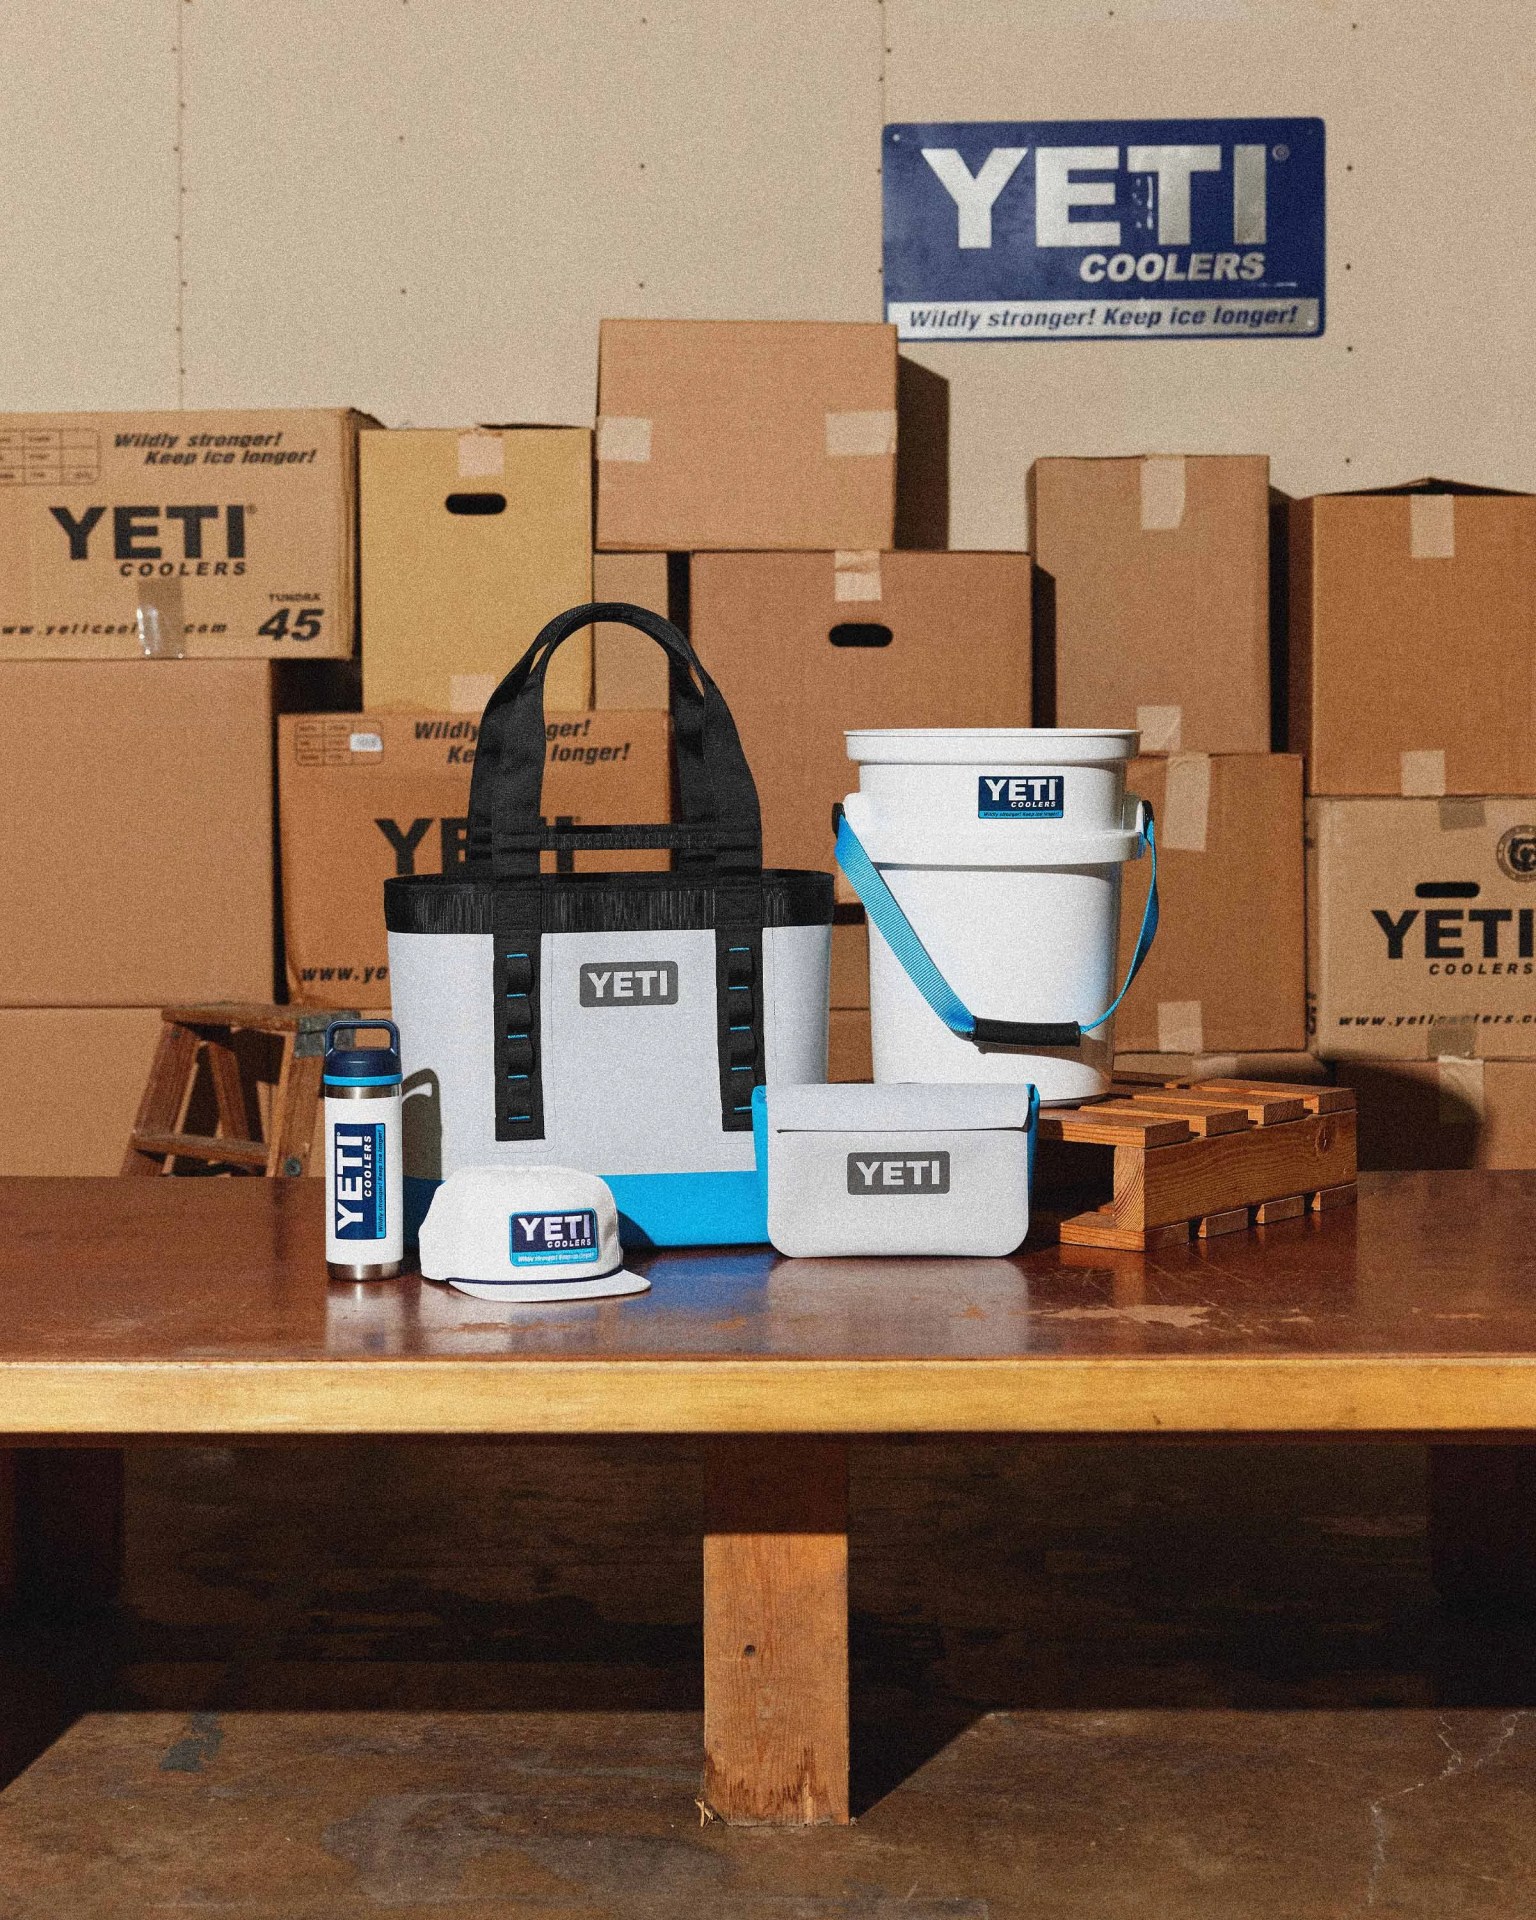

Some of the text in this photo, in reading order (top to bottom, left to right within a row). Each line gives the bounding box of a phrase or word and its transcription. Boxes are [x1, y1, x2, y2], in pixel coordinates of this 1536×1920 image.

[921, 145, 1267, 249] YETI
[1079, 252, 1266, 283] COOLERS
[909, 305, 1298, 331] Wildly stronger! Keep ice longer!
[114, 432, 283, 448] Wildly stronger!
[145, 449, 317, 466] Keep ice longer!
[49, 504, 247, 561] YETI
[119, 562, 247, 577] COOLERS
[258, 608, 325, 642] 45
[447, 743, 631, 765] Ke longer!
[984, 779, 1057, 801] YETI
[1371, 909, 1534, 960] YETI
[302, 966, 389, 984] www.ye
[1429, 963, 1534, 975] COOLERS
[586, 970, 668, 998] YETI
[363, 1135, 372, 1197] COOLERS
[856, 1160, 940, 1186] YETI
[336, 1135, 364, 1232] YETI
[517, 1214, 591, 1242] YETI
[546, 1238, 591, 1248] COOLERS
